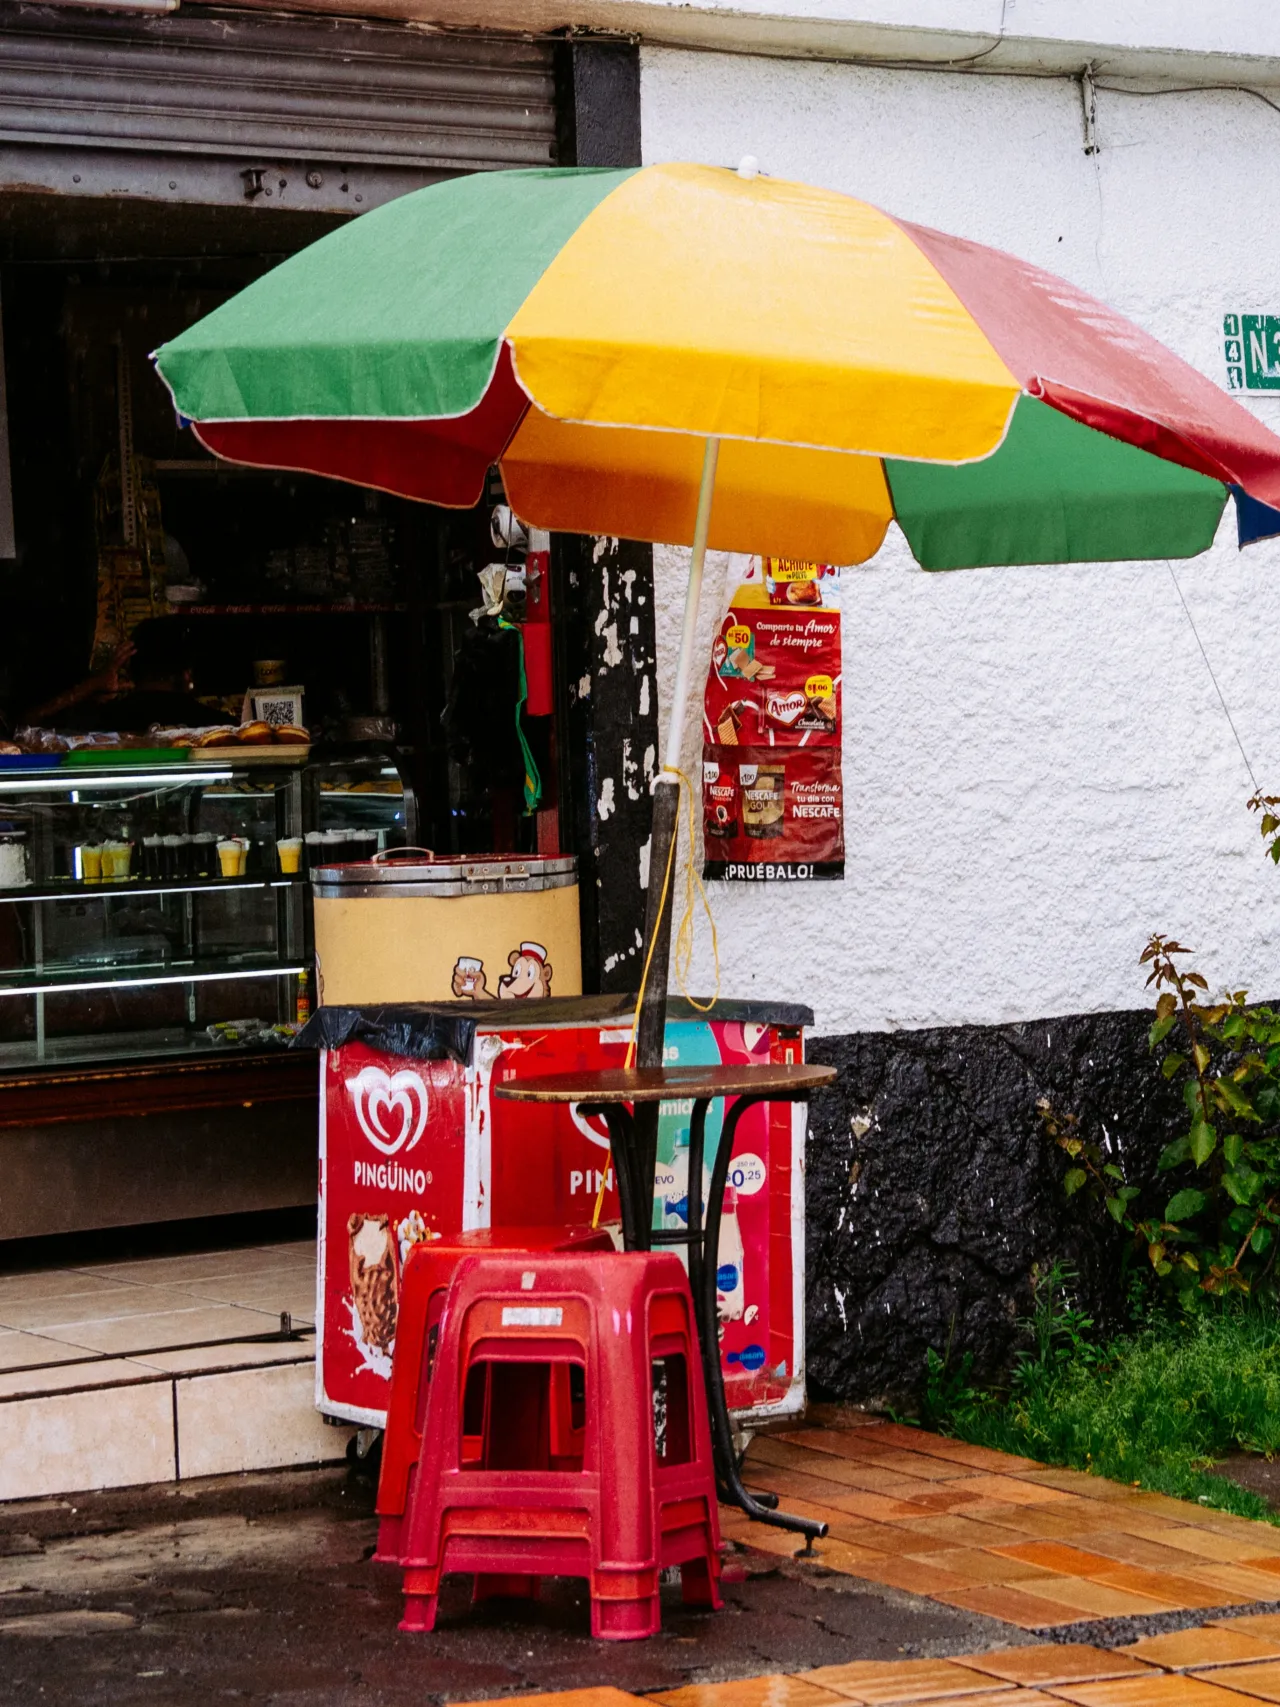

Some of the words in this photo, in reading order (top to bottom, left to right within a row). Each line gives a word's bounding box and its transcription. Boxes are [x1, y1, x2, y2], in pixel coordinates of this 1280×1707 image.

[1250, 331, 1269, 374] N
[795, 624, 804, 632] tu
[804, 619, 836, 636] Amor
[770, 634, 780, 646] de
[782, 635, 823, 653] siempre
[791, 781, 841, 794] Transforma
[725, 864, 814, 879] ¡PRUÉBALO!
